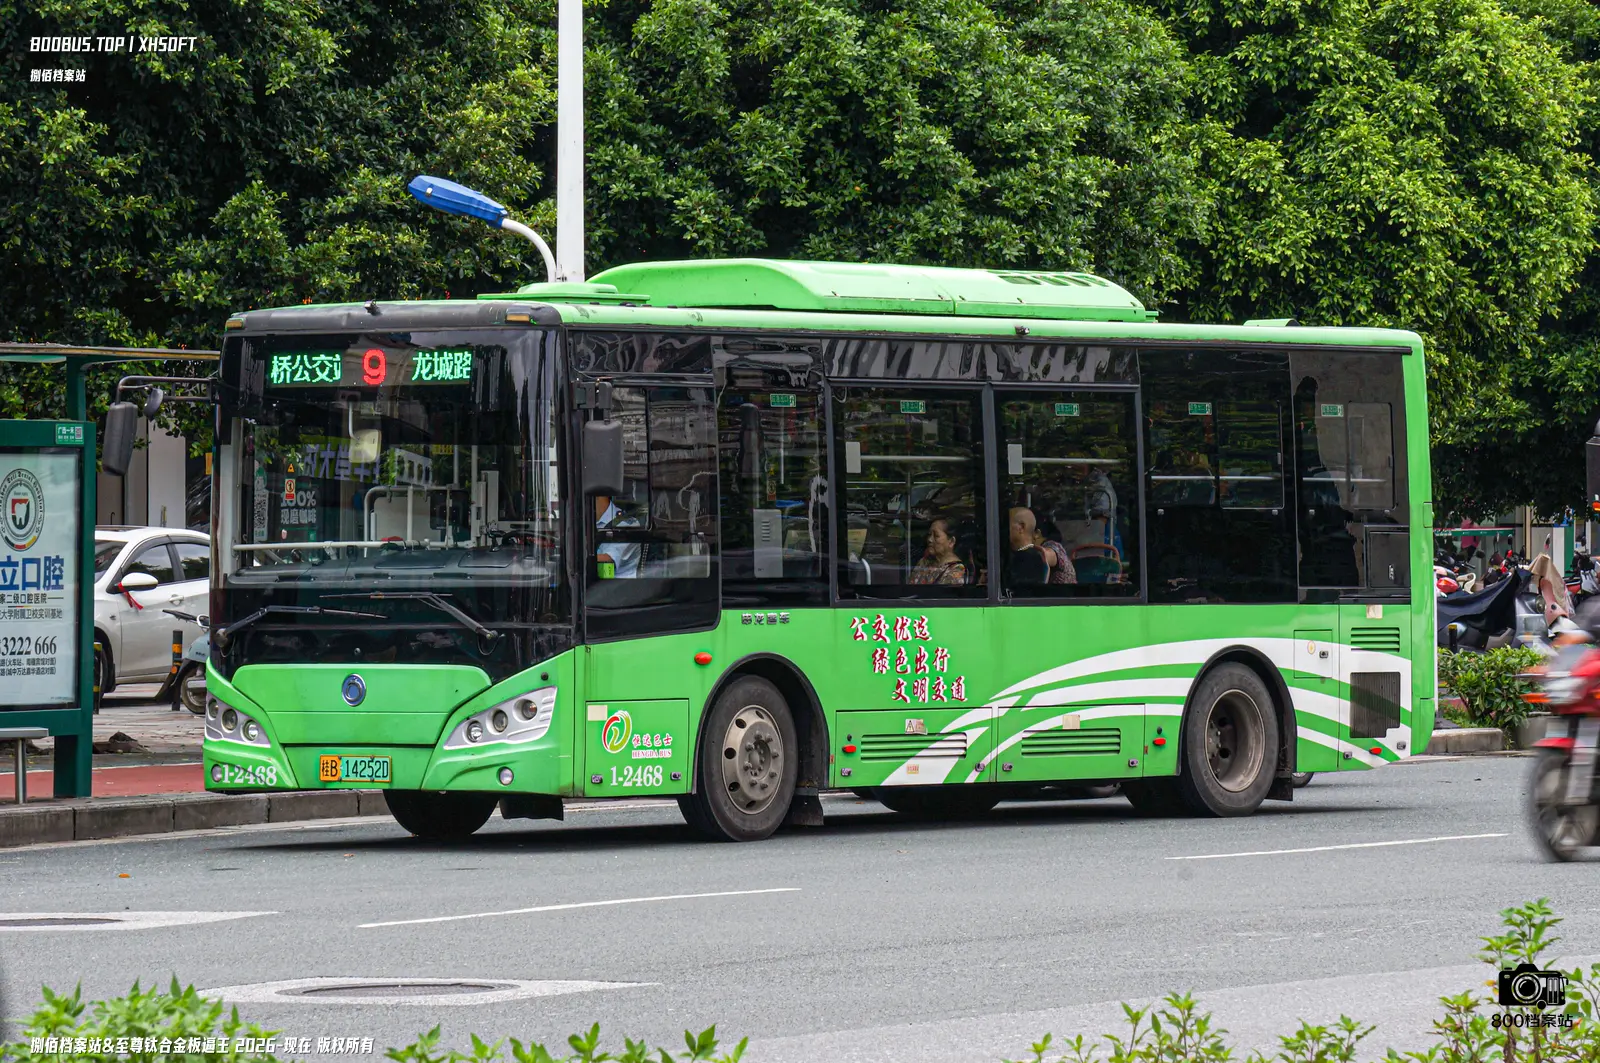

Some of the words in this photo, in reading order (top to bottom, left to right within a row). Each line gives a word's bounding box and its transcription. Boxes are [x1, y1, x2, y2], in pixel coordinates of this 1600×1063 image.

[363, 349, 386, 385] 9
[411, 351, 472, 381] 龙城路
[0, 555, 64, 591] 立口腔
[850, 614, 932, 644] 公交优选
[34, 635, 57, 655] 666
[872, 646, 951, 675] 绿色出行
[892, 676, 968, 703] 文明交通
[632, 733, 673, 748] 恒达巴士
[632, 749, 658, 759] HENGDA
[659, 748, 672, 758] BUS
[222, 763, 277, 786] 1-2468
[345, 758, 389, 779] 14252D
[610, 765, 663, 787] 1-2468
